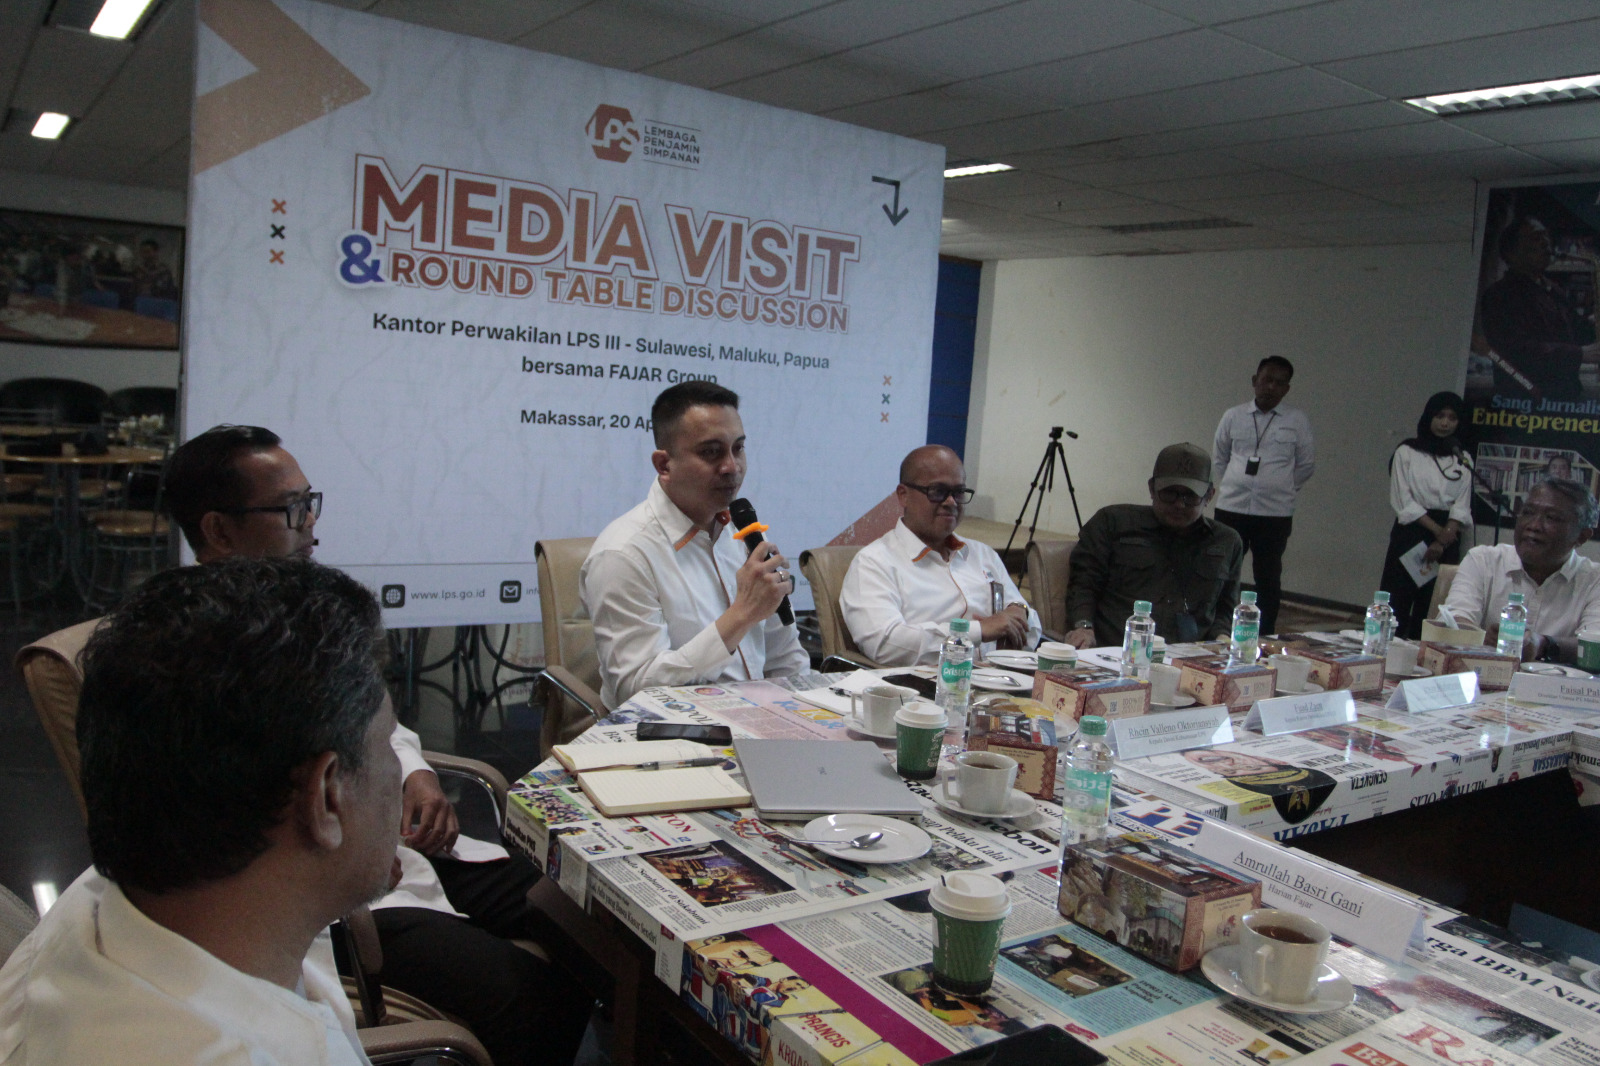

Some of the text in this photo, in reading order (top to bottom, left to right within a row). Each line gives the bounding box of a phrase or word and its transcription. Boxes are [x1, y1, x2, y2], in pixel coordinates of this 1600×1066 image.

[643, 136, 700, 154] PENJAMIN
[644, 125, 697, 143] LEMBAGA
[643, 146, 700, 164] SIMPANAN
[356, 157, 860, 301] MEDIA VISIT
[340, 233, 849, 332] & ROUND TABLE DISCUSSION
[372, 312, 446, 335] Kantor
[451, 320, 562, 345] Perwakilan
[567, 331, 600, 349] LPS
[605, 335, 620, 350] III
[635, 337, 715, 361] Sulawesi,
[719, 345, 780, 367] Maluku,
[783, 352, 830, 369] Papua
[522, 356, 604, 378] bersama
[609, 364, 662, 383] FAJAR
[1491, 394, 1532, 414] Sang
[521, 409, 605, 430] Makassar,
[609, 415, 631, 429] 20
[1472, 407, 1600, 434] Entrepreneu
[411, 588, 486, 601] www.lps.go.id
[1560, 685, 1585, 696] Faisal
[942, 826, 1012, 862] Pelaku Lalai
[1233, 850, 1365, 916] Amrullah Basri Gani
[1268, 883, 1298, 904] Harian
[676, 899, 710, 926] Sukabumi
[1427, 936, 1600, 1014] rga BBM Nai
[799, 1013, 851, 1048] PRANCIS
